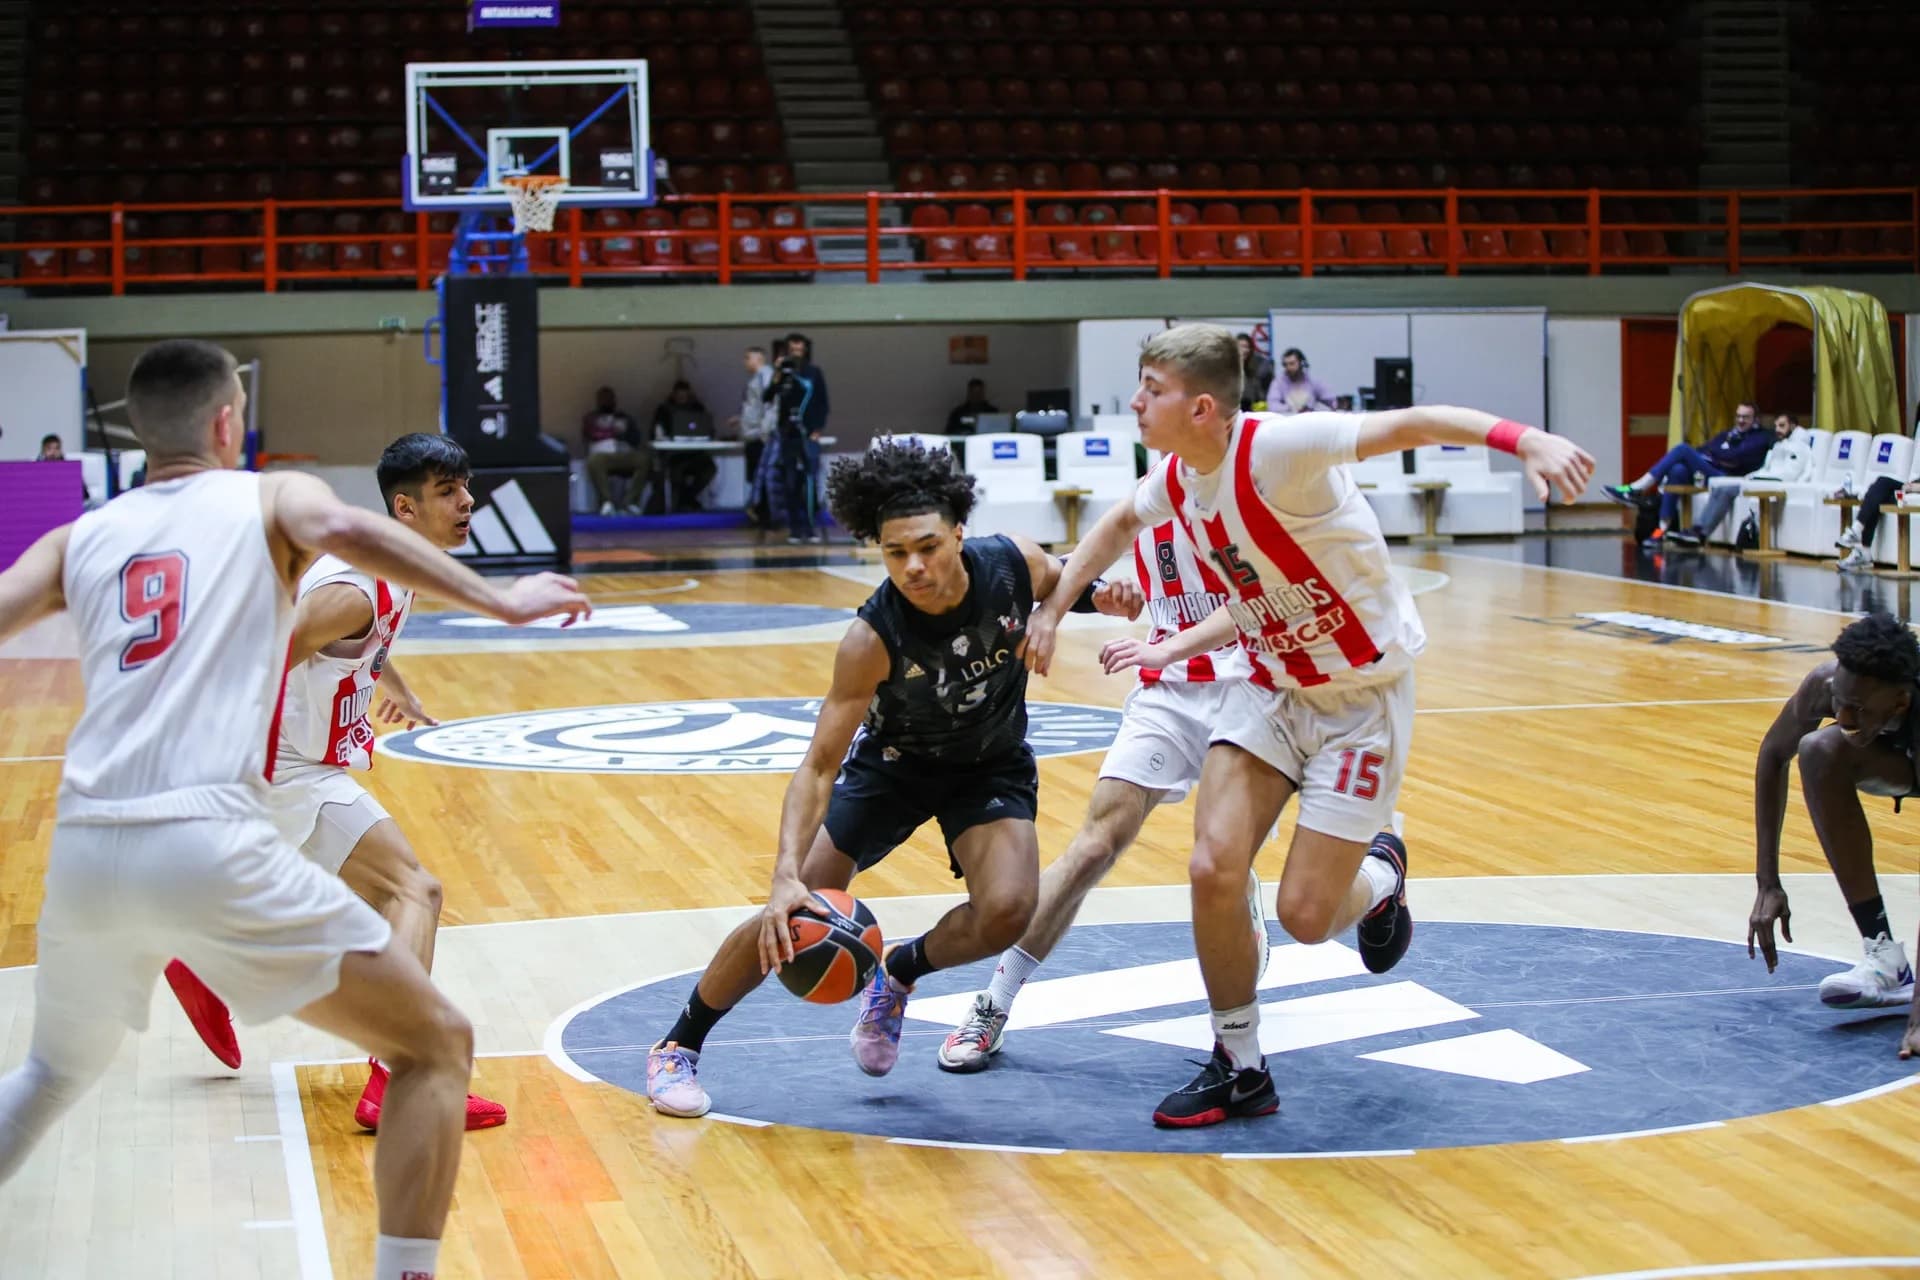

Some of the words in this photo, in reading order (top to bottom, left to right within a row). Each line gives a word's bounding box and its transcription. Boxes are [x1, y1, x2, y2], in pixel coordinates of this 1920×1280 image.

[1157, 541, 1179, 582] 8
[1210, 543, 1260, 589] 15
[119, 549, 189, 672] 9
[961, 648, 1010, 682] LDLC
[1333, 748, 1385, 801] 15
